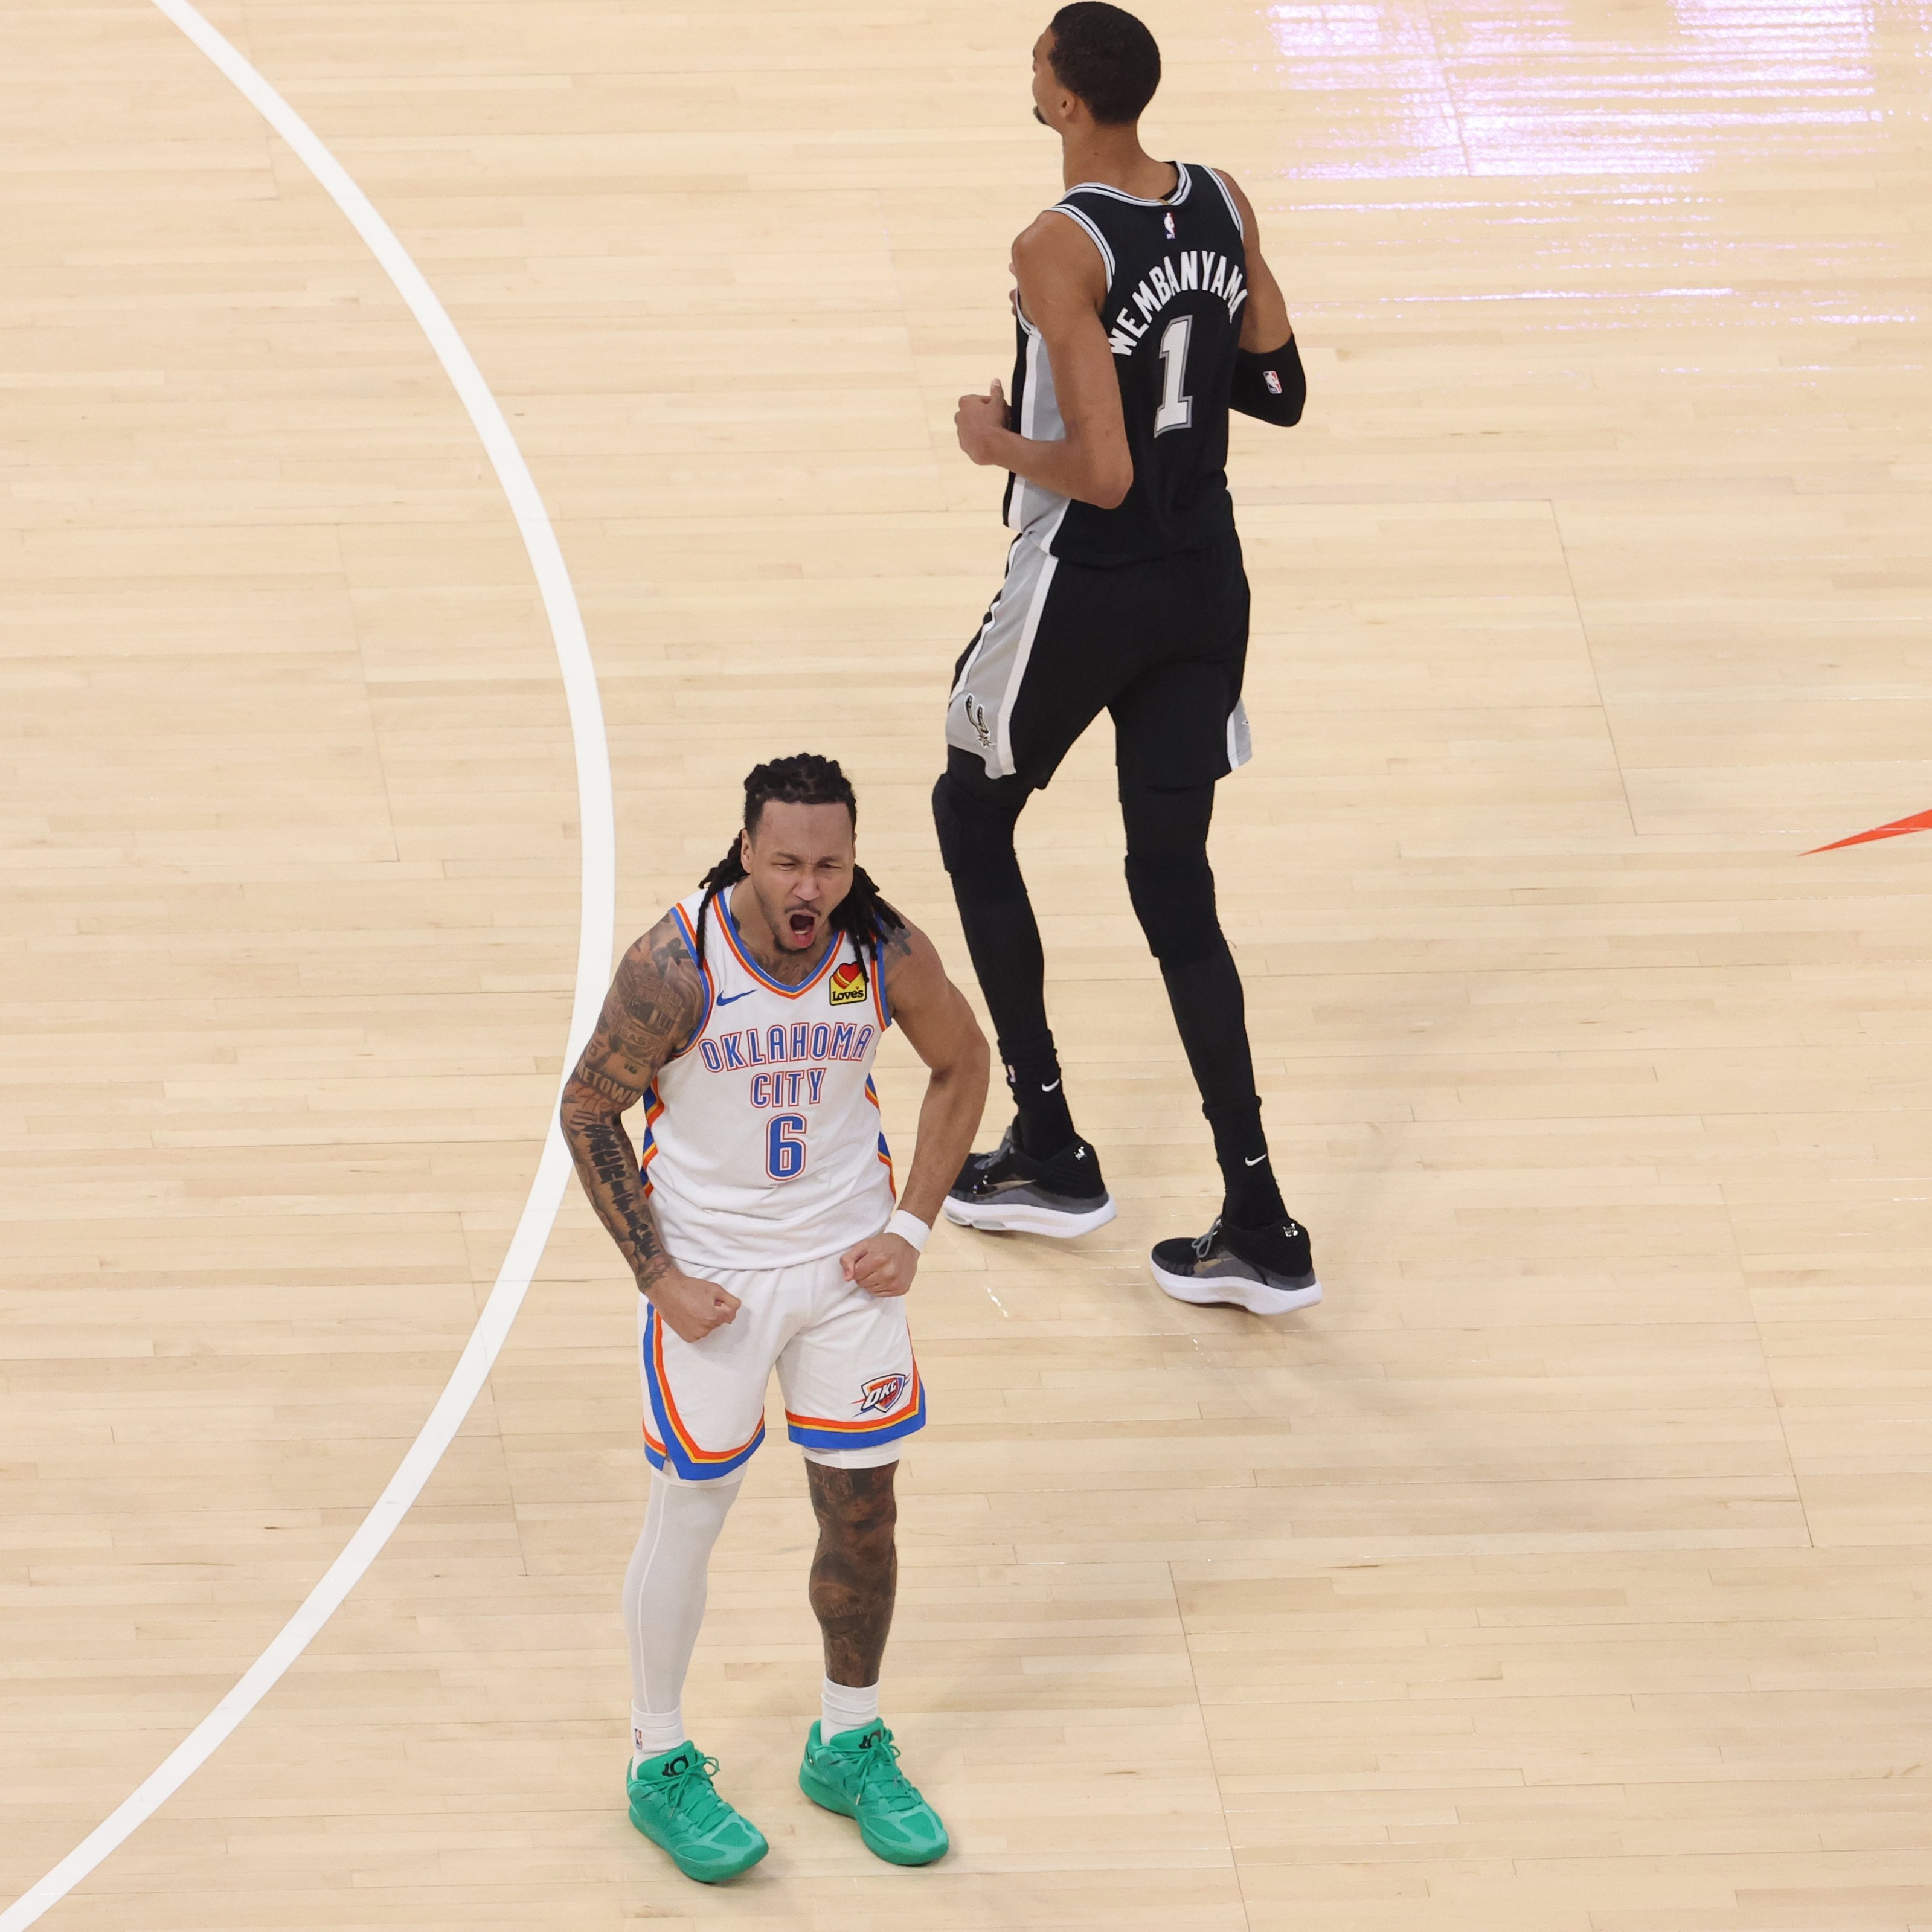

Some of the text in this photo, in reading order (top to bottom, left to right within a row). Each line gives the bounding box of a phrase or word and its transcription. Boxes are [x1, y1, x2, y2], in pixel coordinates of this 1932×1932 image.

[1154, 314, 1193, 438] 1
[698, 1022, 875, 1073] OKLAHOMA
[750, 1067, 827, 1108] CITY
[765, 1112, 807, 1181] 6
